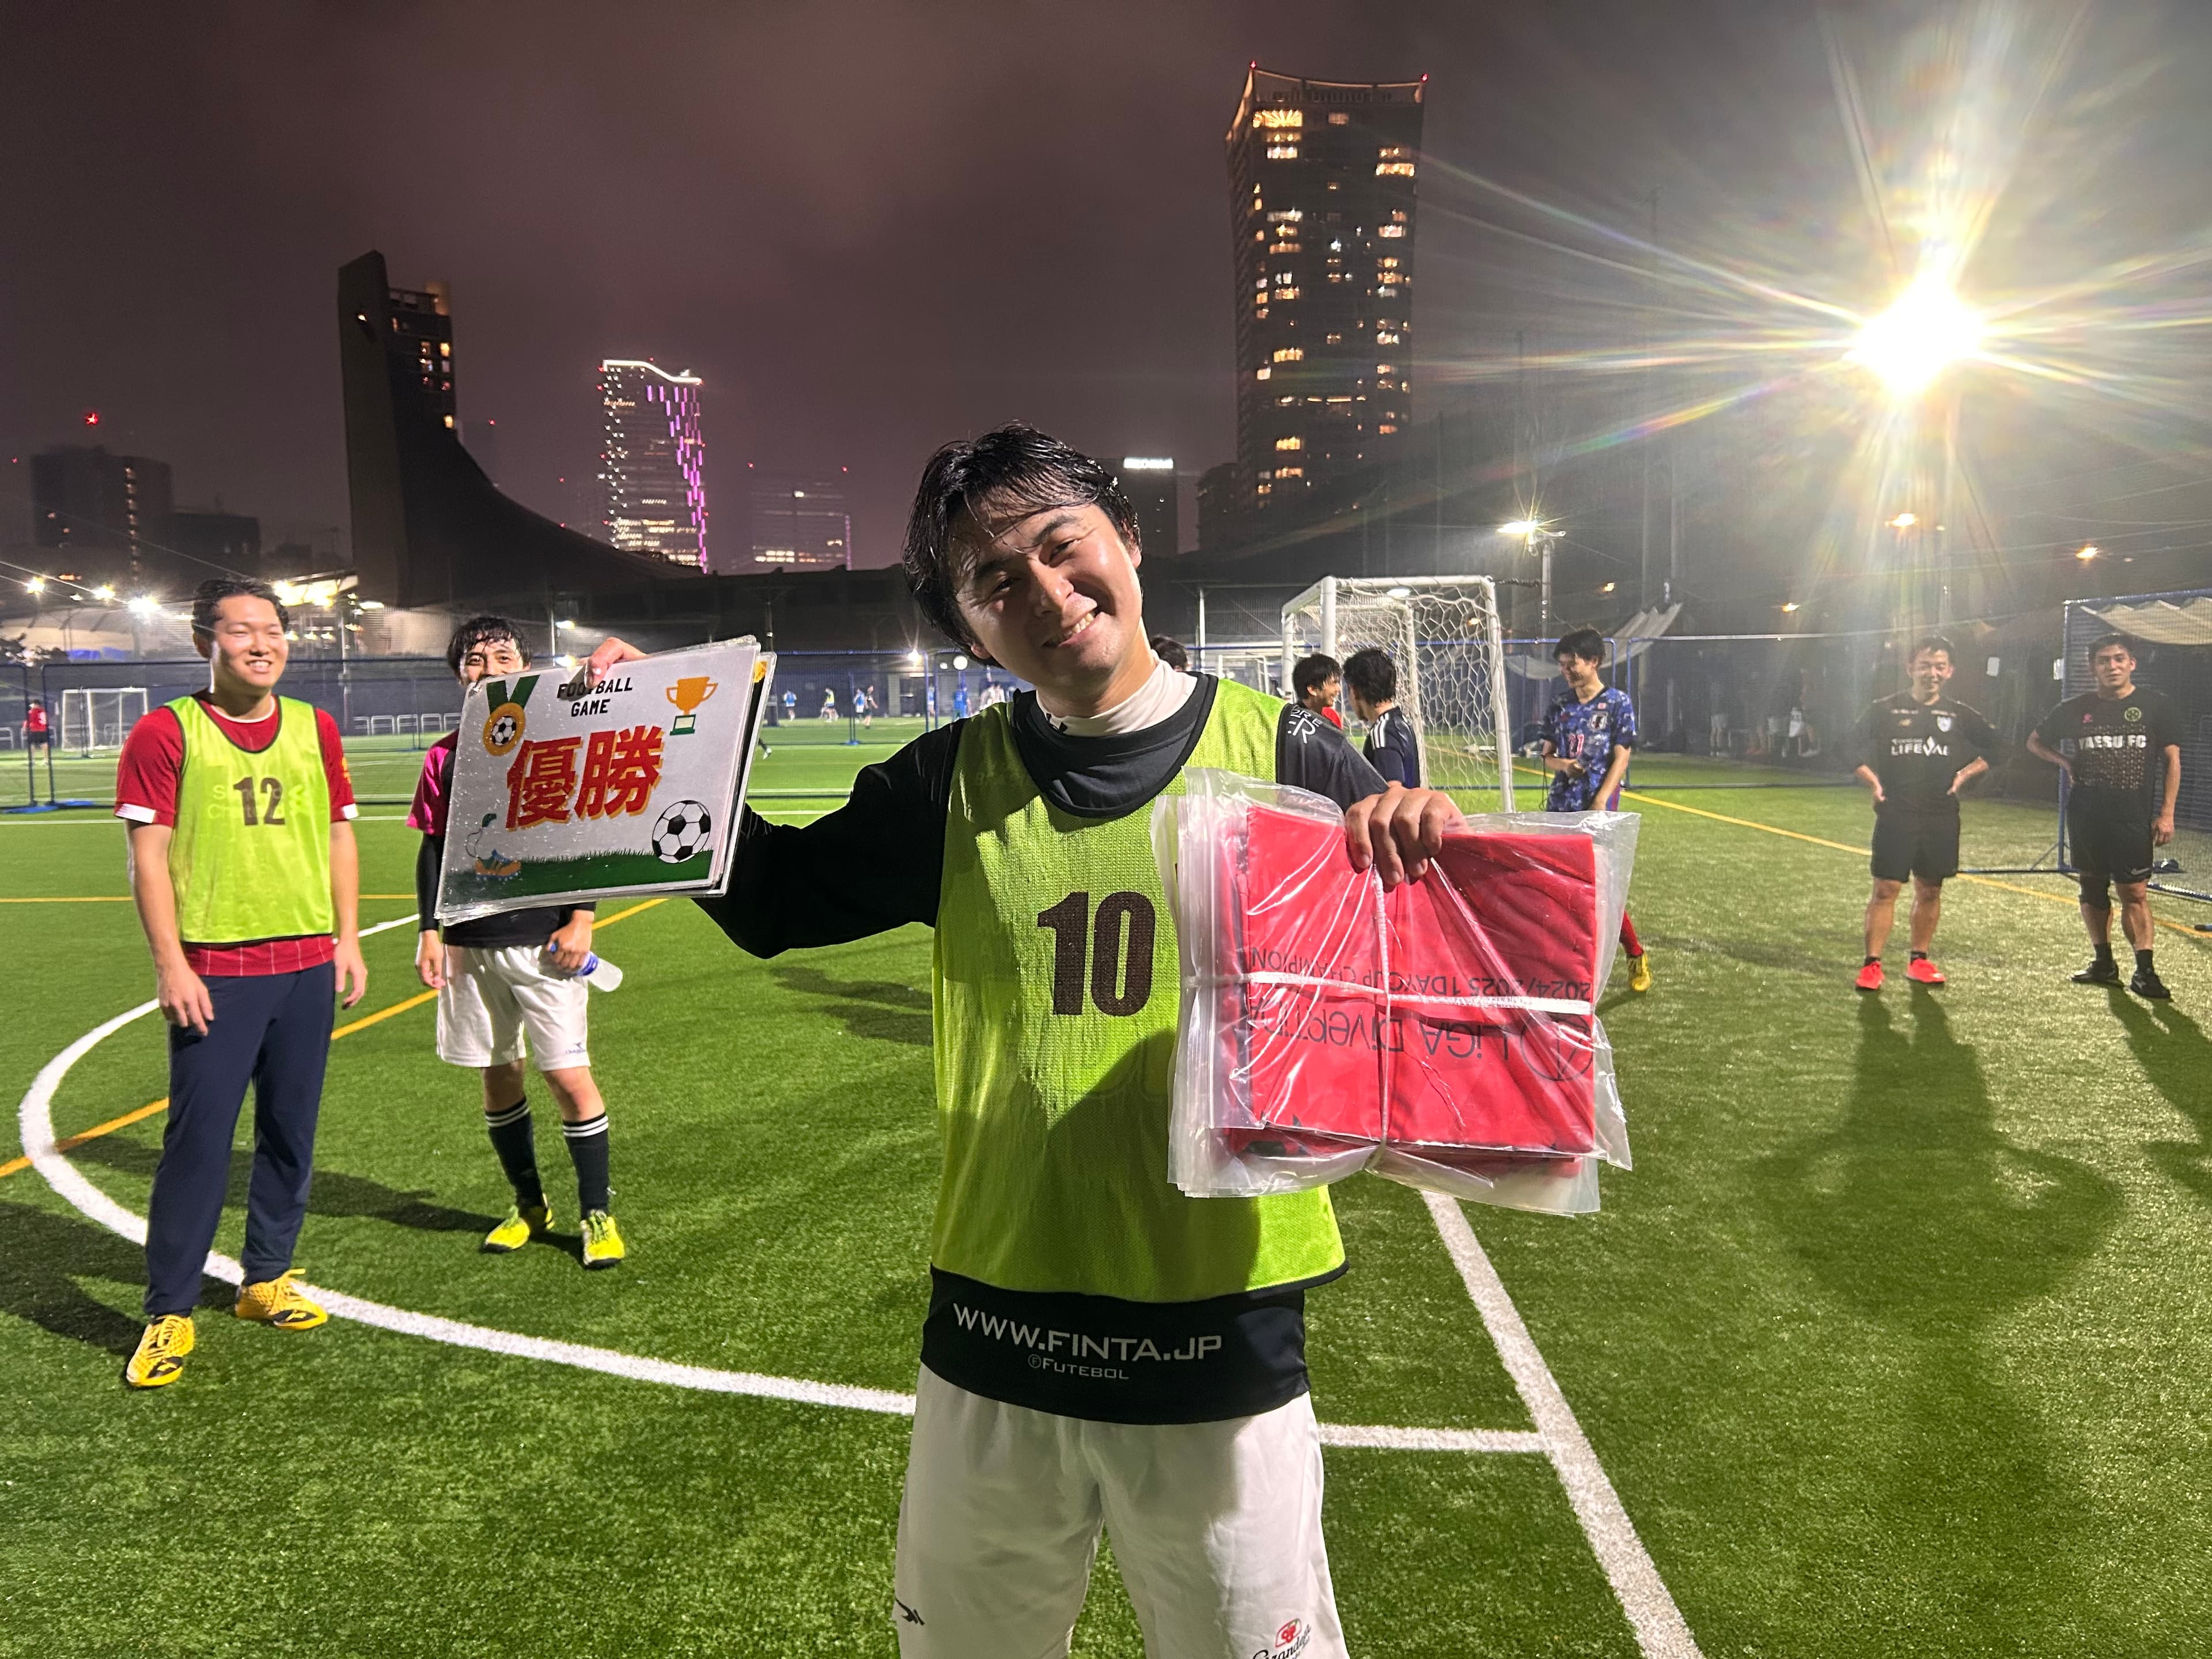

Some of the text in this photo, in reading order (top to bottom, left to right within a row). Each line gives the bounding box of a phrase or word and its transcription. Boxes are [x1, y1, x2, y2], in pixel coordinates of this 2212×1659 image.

[556, 677, 633, 698] FOOBALL
[571, 699, 611, 717] GAME
[2078, 734, 2146, 750] YAESU FC
[233, 777, 286, 825] 12
[505, 725, 665, 832] 優勝
[1037, 891, 1156, 1017] 10
[953, 1303, 1222, 1362] WWW.FINTA.JP
